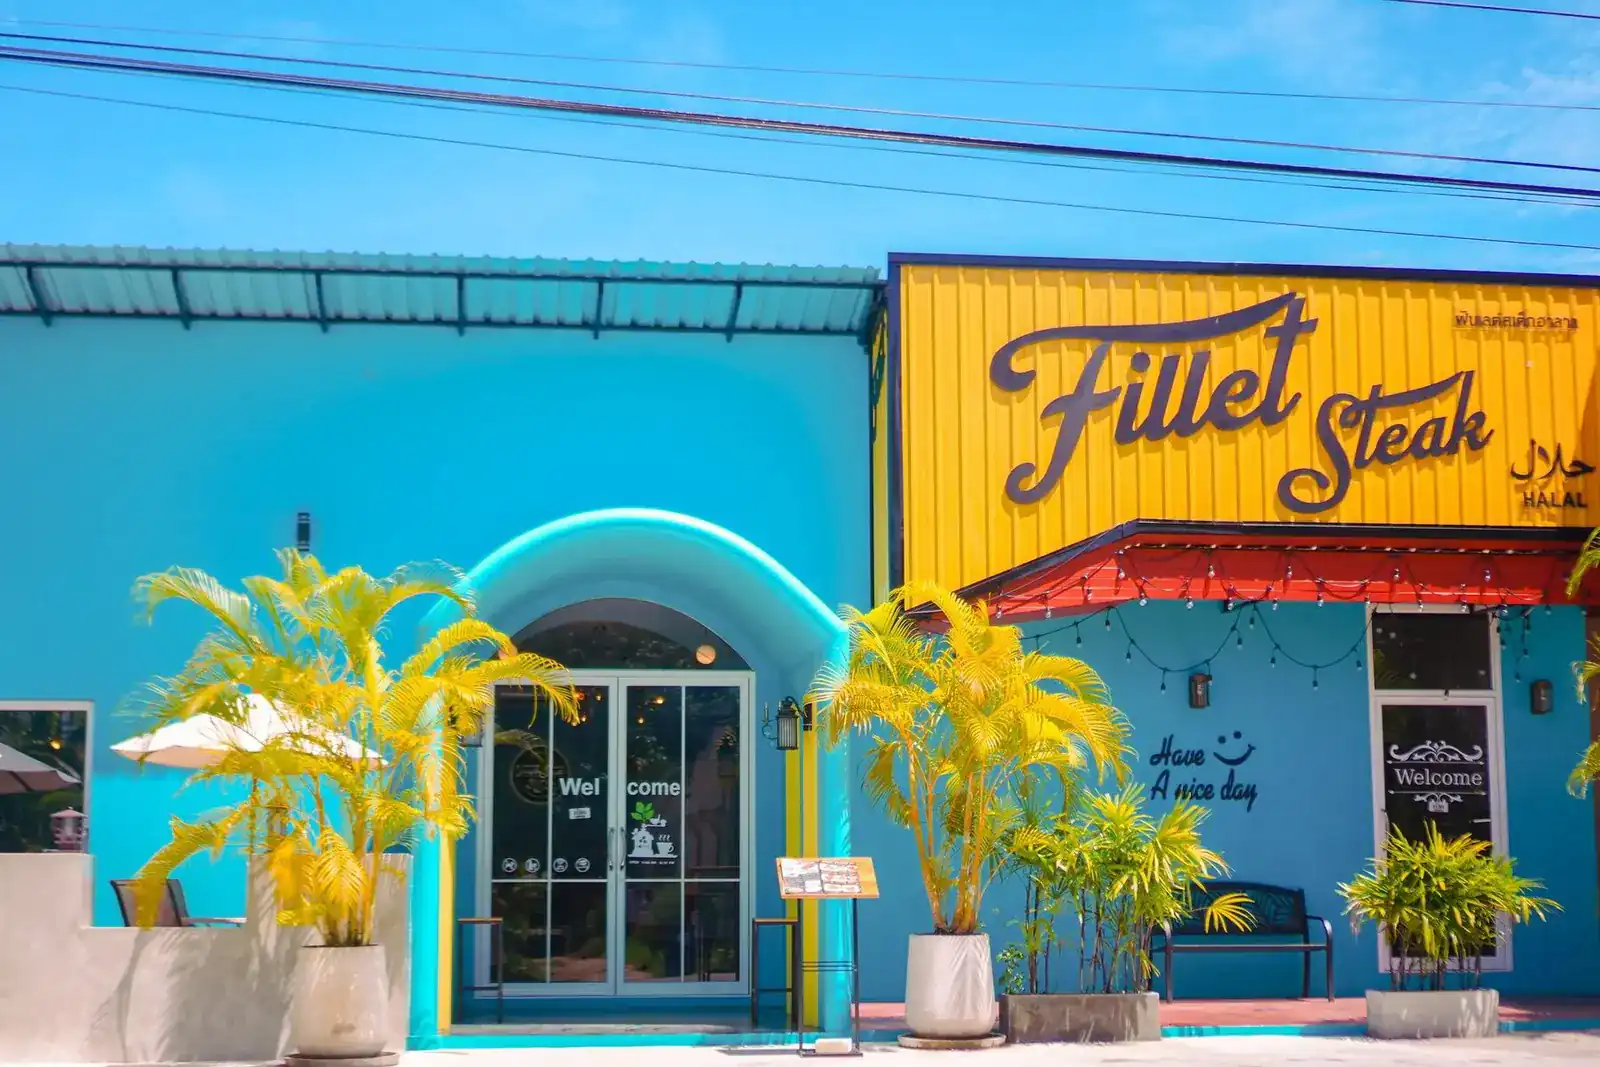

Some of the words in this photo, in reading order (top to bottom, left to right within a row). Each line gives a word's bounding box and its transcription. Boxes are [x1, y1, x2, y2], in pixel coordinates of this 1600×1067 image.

[990, 291, 1319, 505] Fillet
[1277, 370, 1495, 513] Steak
[1511, 439, 1596, 480] حلال
[1523, 492, 1588, 508] HALAL
[1149, 734, 1206, 767] Have
[559, 777, 600, 796] Wel
[627, 780, 681, 796] come
[1150, 769, 1171, 800] A
[1174, 777, 1215, 800] nice
[1220, 768, 1258, 813] day
[1394, 768, 1483, 786] Welcome
